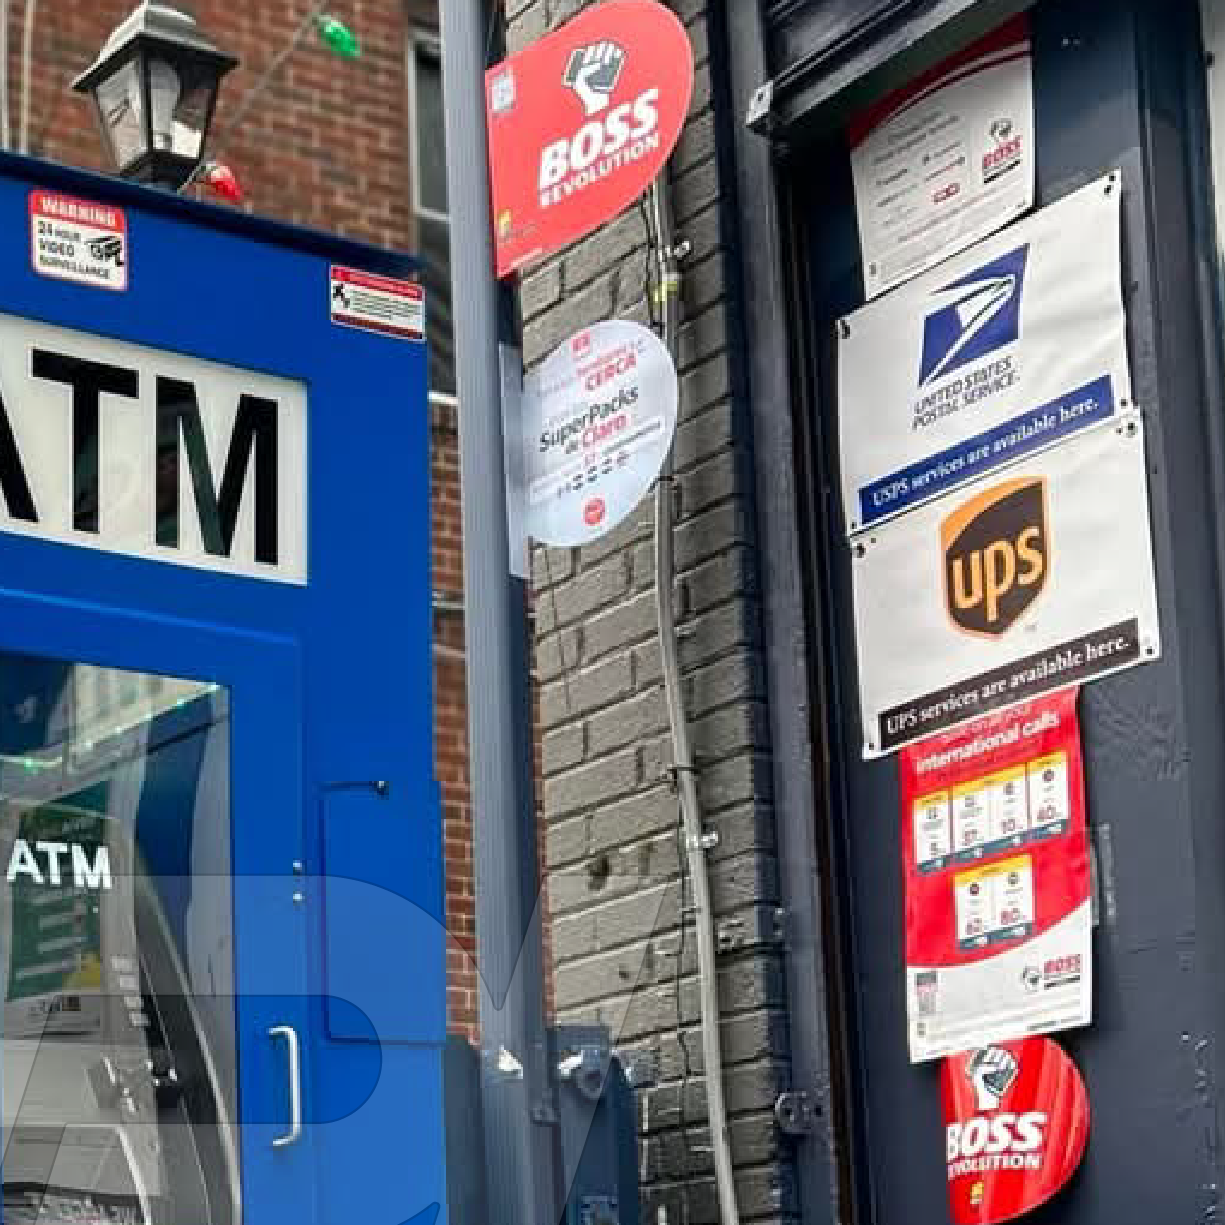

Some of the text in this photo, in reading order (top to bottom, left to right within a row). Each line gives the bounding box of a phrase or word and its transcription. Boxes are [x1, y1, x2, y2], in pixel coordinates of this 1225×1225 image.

[539, 87, 659, 190] BOSS
[539, 131, 660, 207] REVOLUTION
[38, 219, 53, 236] 24
[40, 195, 117, 227] WARNING
[39, 238, 74, 257] VIDEO
[39, 254, 110, 279] SURVEILLANCE
[911, 399, 959, 432] POSTAL
[913, 355, 1013, 416] UNITED STATES
[539, 385, 639, 453] SuperPacks
[872, 397, 1099, 507] USPS services are available here.
[952, 525, 1044, 623] ups
[886, 706, 917, 734] UPS
[921, 690, 979, 723] services
[981, 678, 1007, 700] are
[1010, 650, 1084, 690] available
[1086, 634, 1131, 662] here.
[917, 722, 1020, 774] international
[1022, 709, 1061, 737] calls
[6, 838, 113, 889] ATM
[946, 1112, 1048, 1164] BOSS
